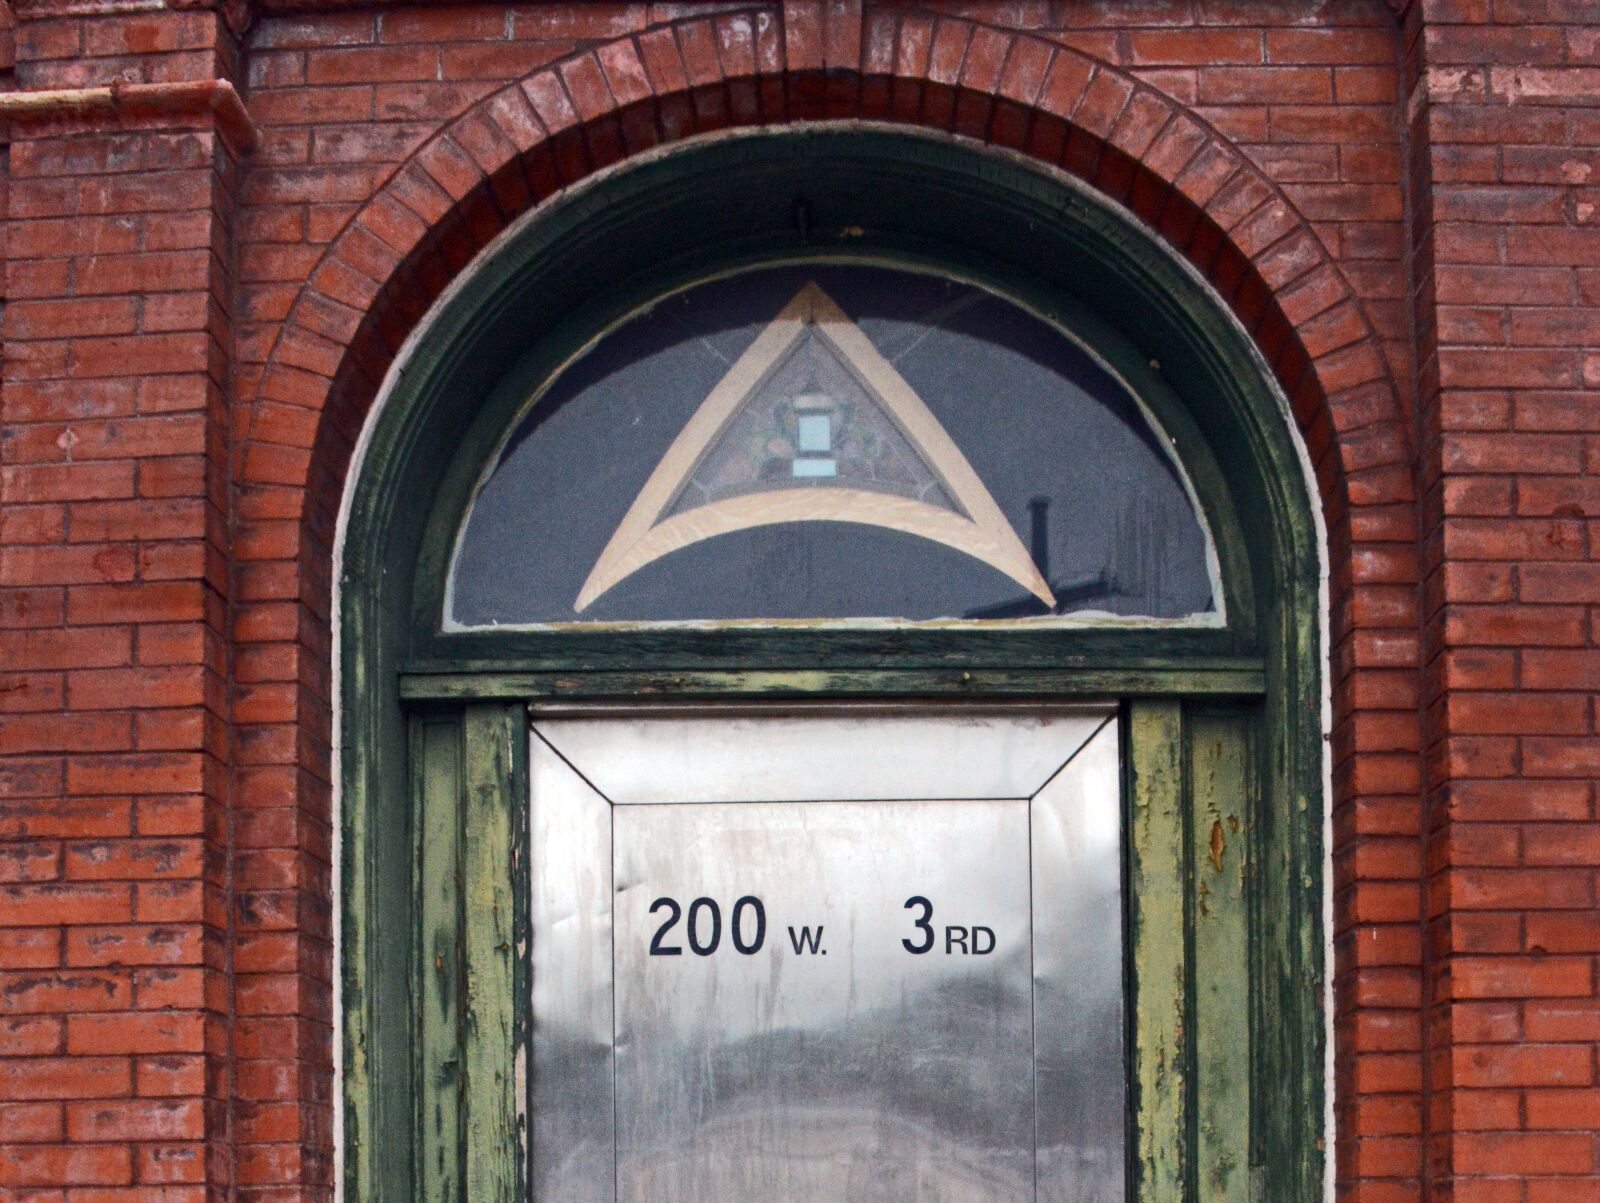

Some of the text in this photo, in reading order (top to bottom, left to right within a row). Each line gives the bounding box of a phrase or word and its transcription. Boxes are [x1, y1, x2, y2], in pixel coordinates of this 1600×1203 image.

[648, 895, 997, 957] 200 W. 3RD
